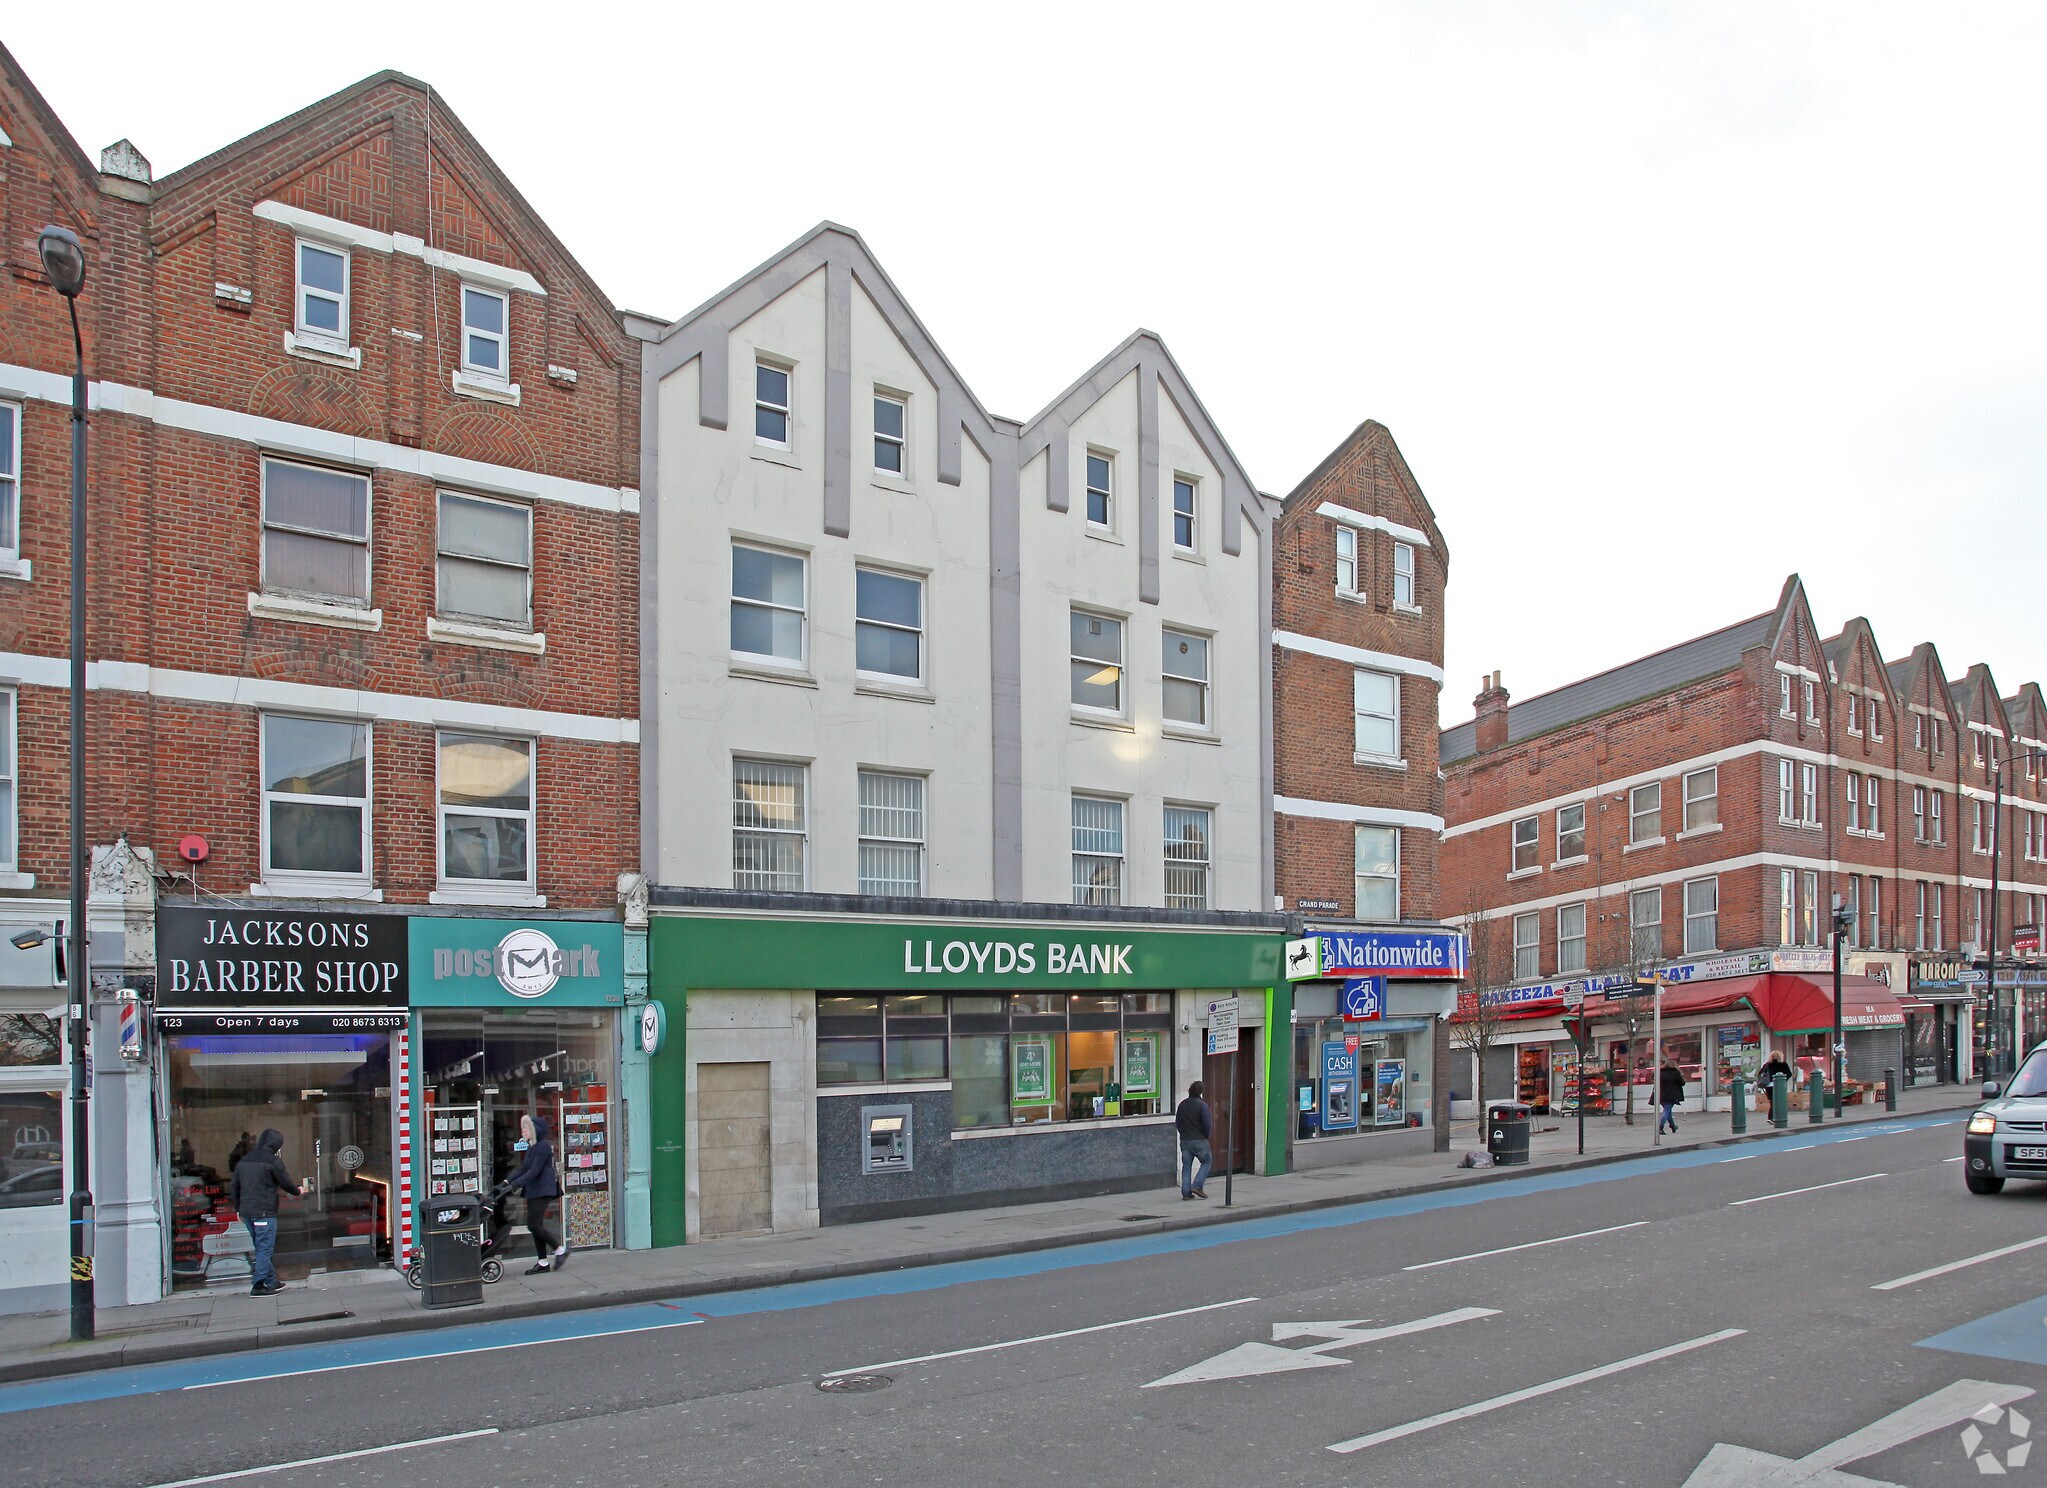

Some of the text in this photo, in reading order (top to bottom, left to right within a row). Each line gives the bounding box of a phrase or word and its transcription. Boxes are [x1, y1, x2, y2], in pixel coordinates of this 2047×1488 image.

[1318, 901, 1339, 909] PARADE
[203, 919, 369, 948] JACKSONS
[904, 940, 1133, 974] LLOYDS BANK
[1336, 938, 1443, 966] Nationwide
[1705, 956, 1746, 966] WHOLESALE
[1715, 963, 1742, 971] RETAIL
[170, 959, 399, 993] BARBER SHOP
[163, 1016, 401, 1028] 123 Open 7 days 020 8673 6313
[1858, 1015, 1873, 1025] MEAT
[1873, 1015, 1879, 1024] &
[1878, 1014, 1903, 1023] GROCERY
[1345, 1037, 1358, 1046] FREE
[1327, 1057, 1353, 1071] CASH
[2021, 1148, 2047, 1158] SF5
[183, 1185, 220, 1195] Price List
